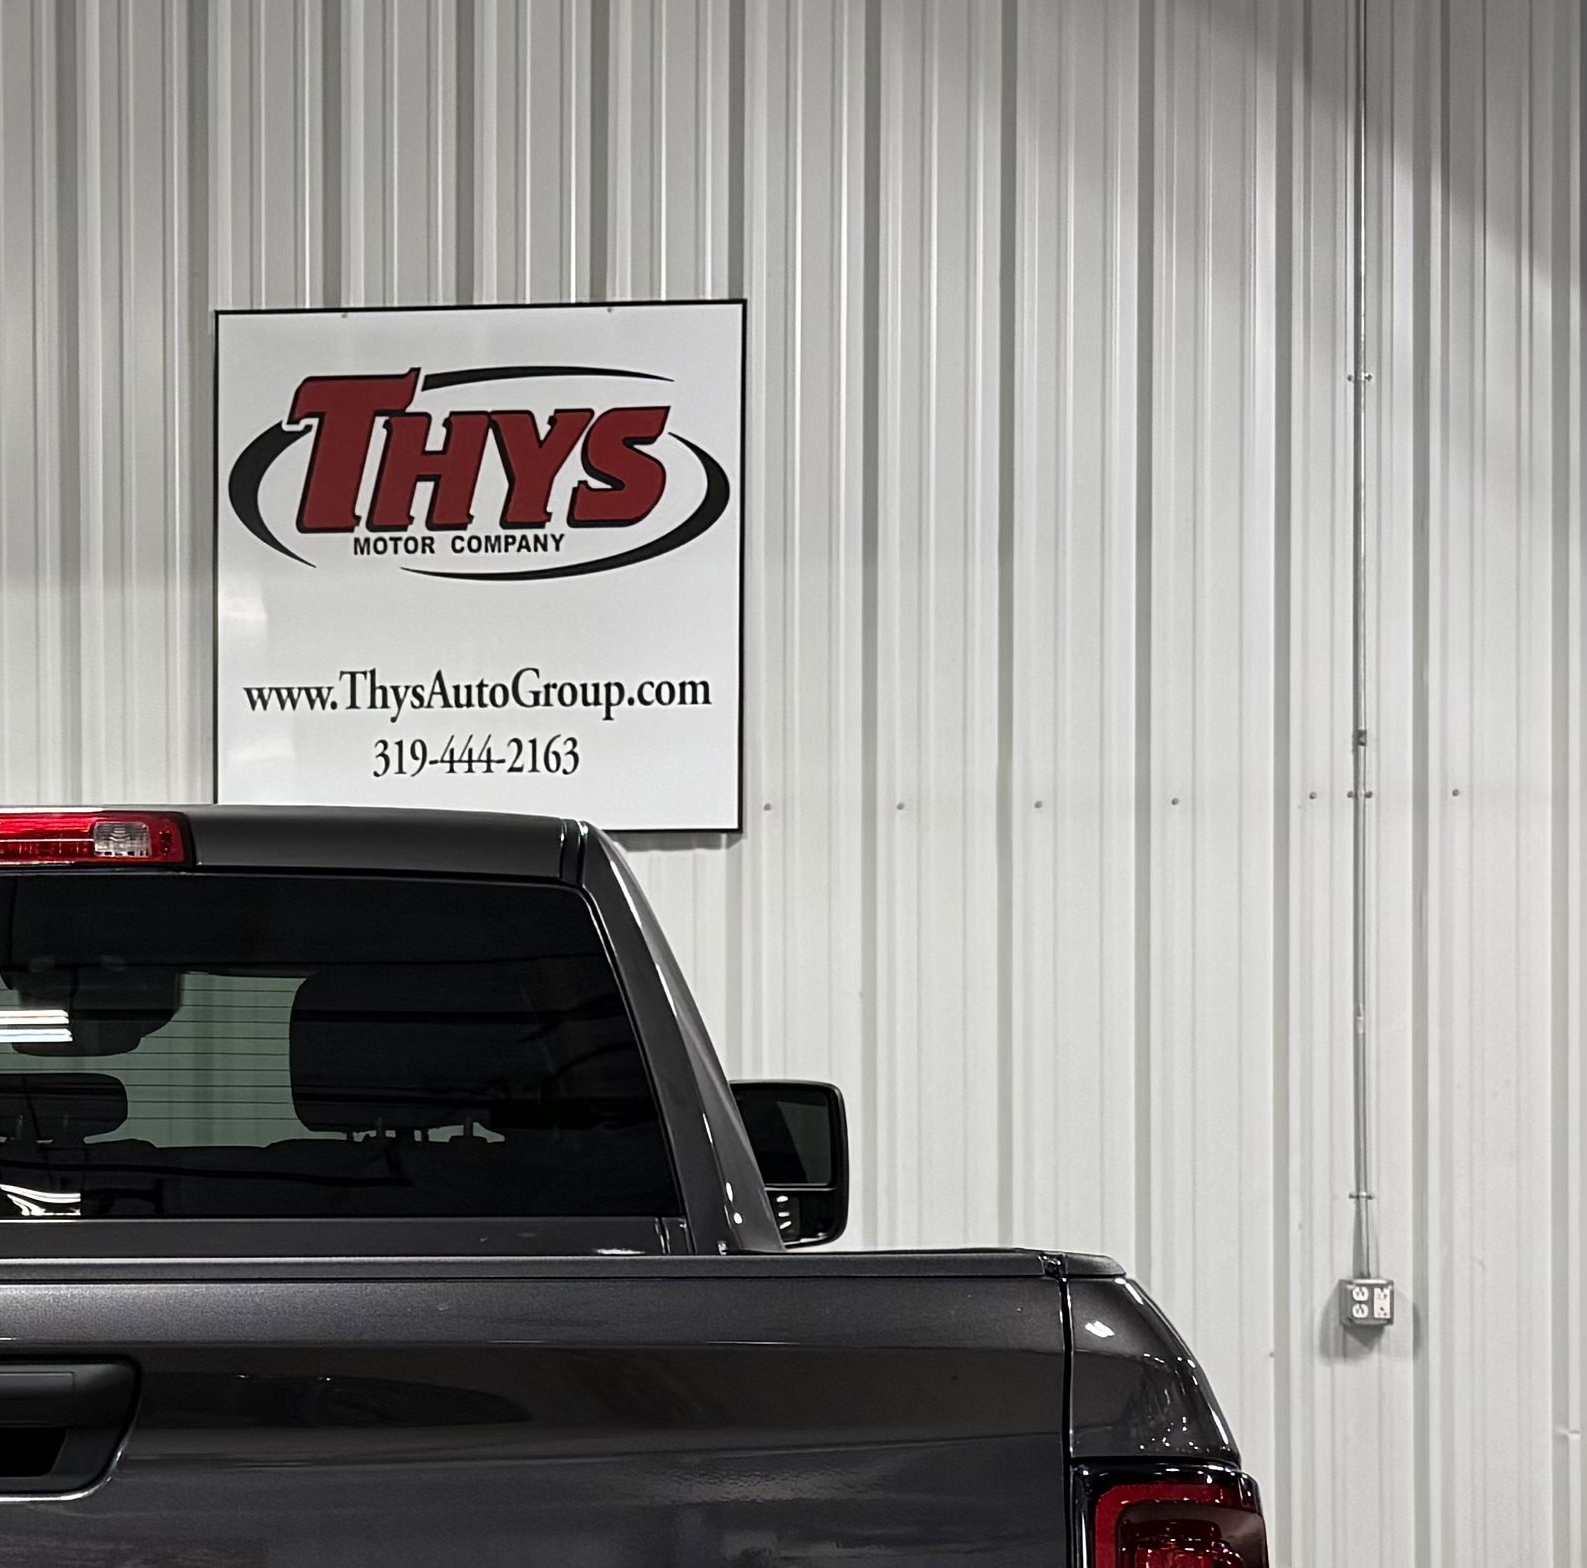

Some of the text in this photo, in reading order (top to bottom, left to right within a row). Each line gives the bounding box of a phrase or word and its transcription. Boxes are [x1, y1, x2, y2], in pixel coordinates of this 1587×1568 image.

[286, 366, 672, 534] THYS
[353, 533, 565, 555] MOTOR COMPANY
[242, 667, 712, 722] www.ThysAutoGroup.com
[372, 734, 580, 777] 319-444-2163
